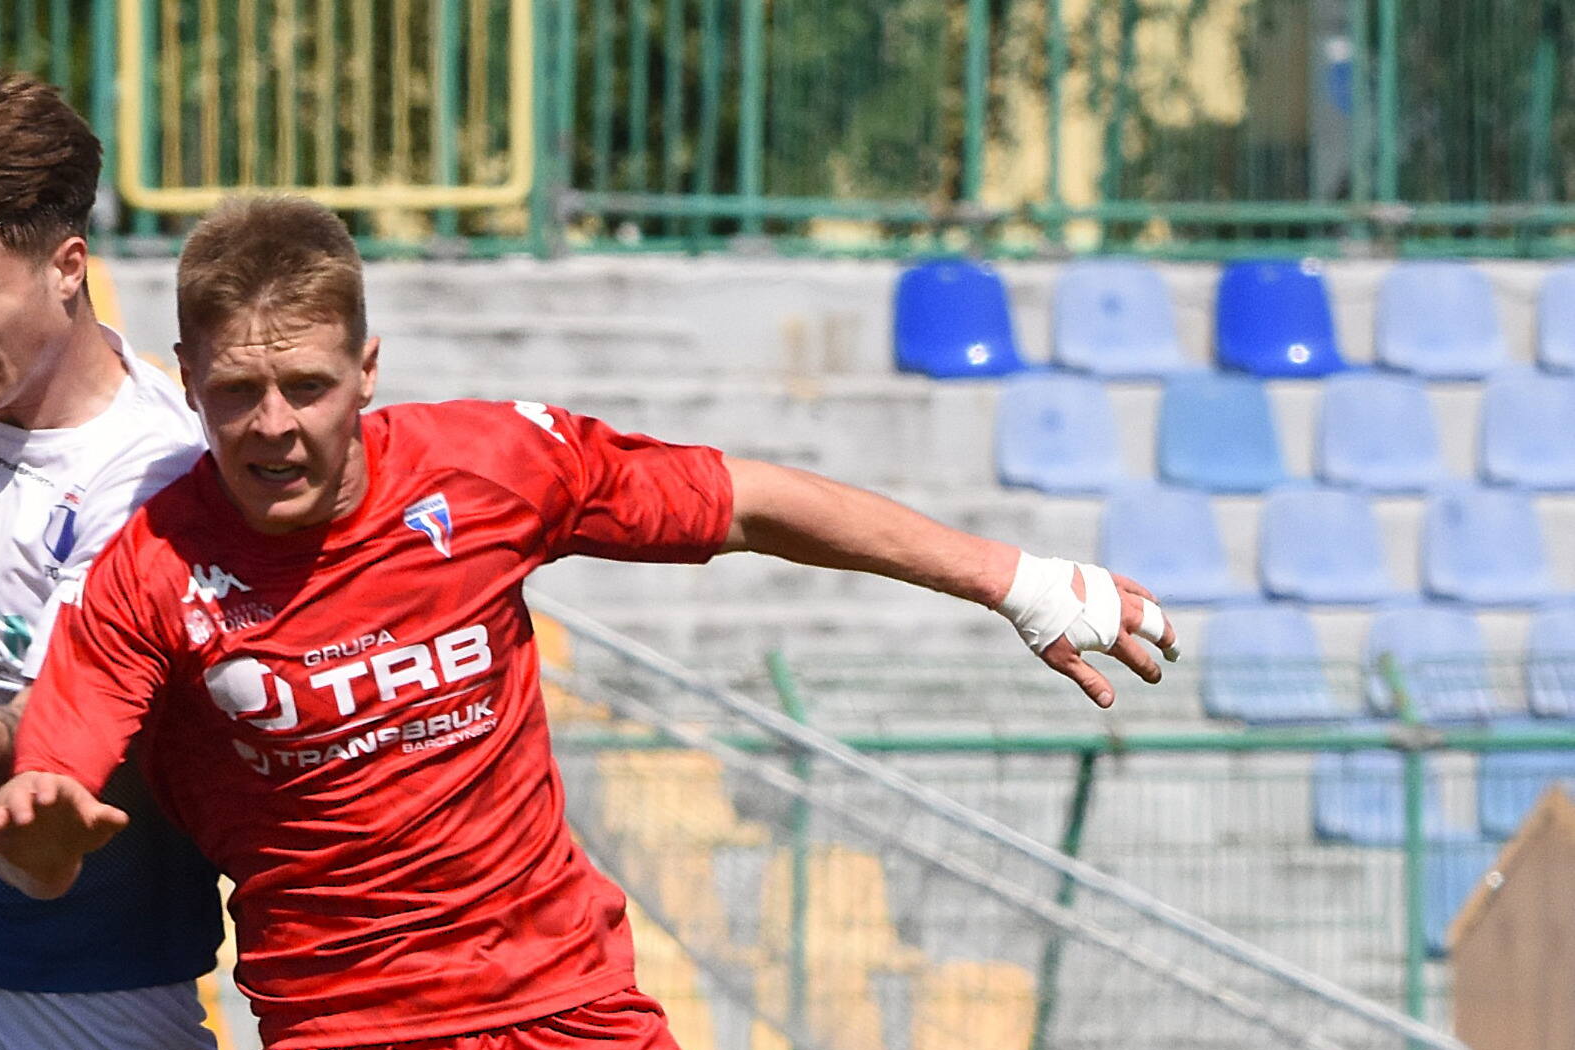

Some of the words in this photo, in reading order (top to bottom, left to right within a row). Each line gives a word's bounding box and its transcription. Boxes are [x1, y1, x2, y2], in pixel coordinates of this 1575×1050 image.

[303, 629, 397, 667] GRUPA
[309, 624, 492, 716] TRB
[277, 697, 495, 768] TRANSBRUK
